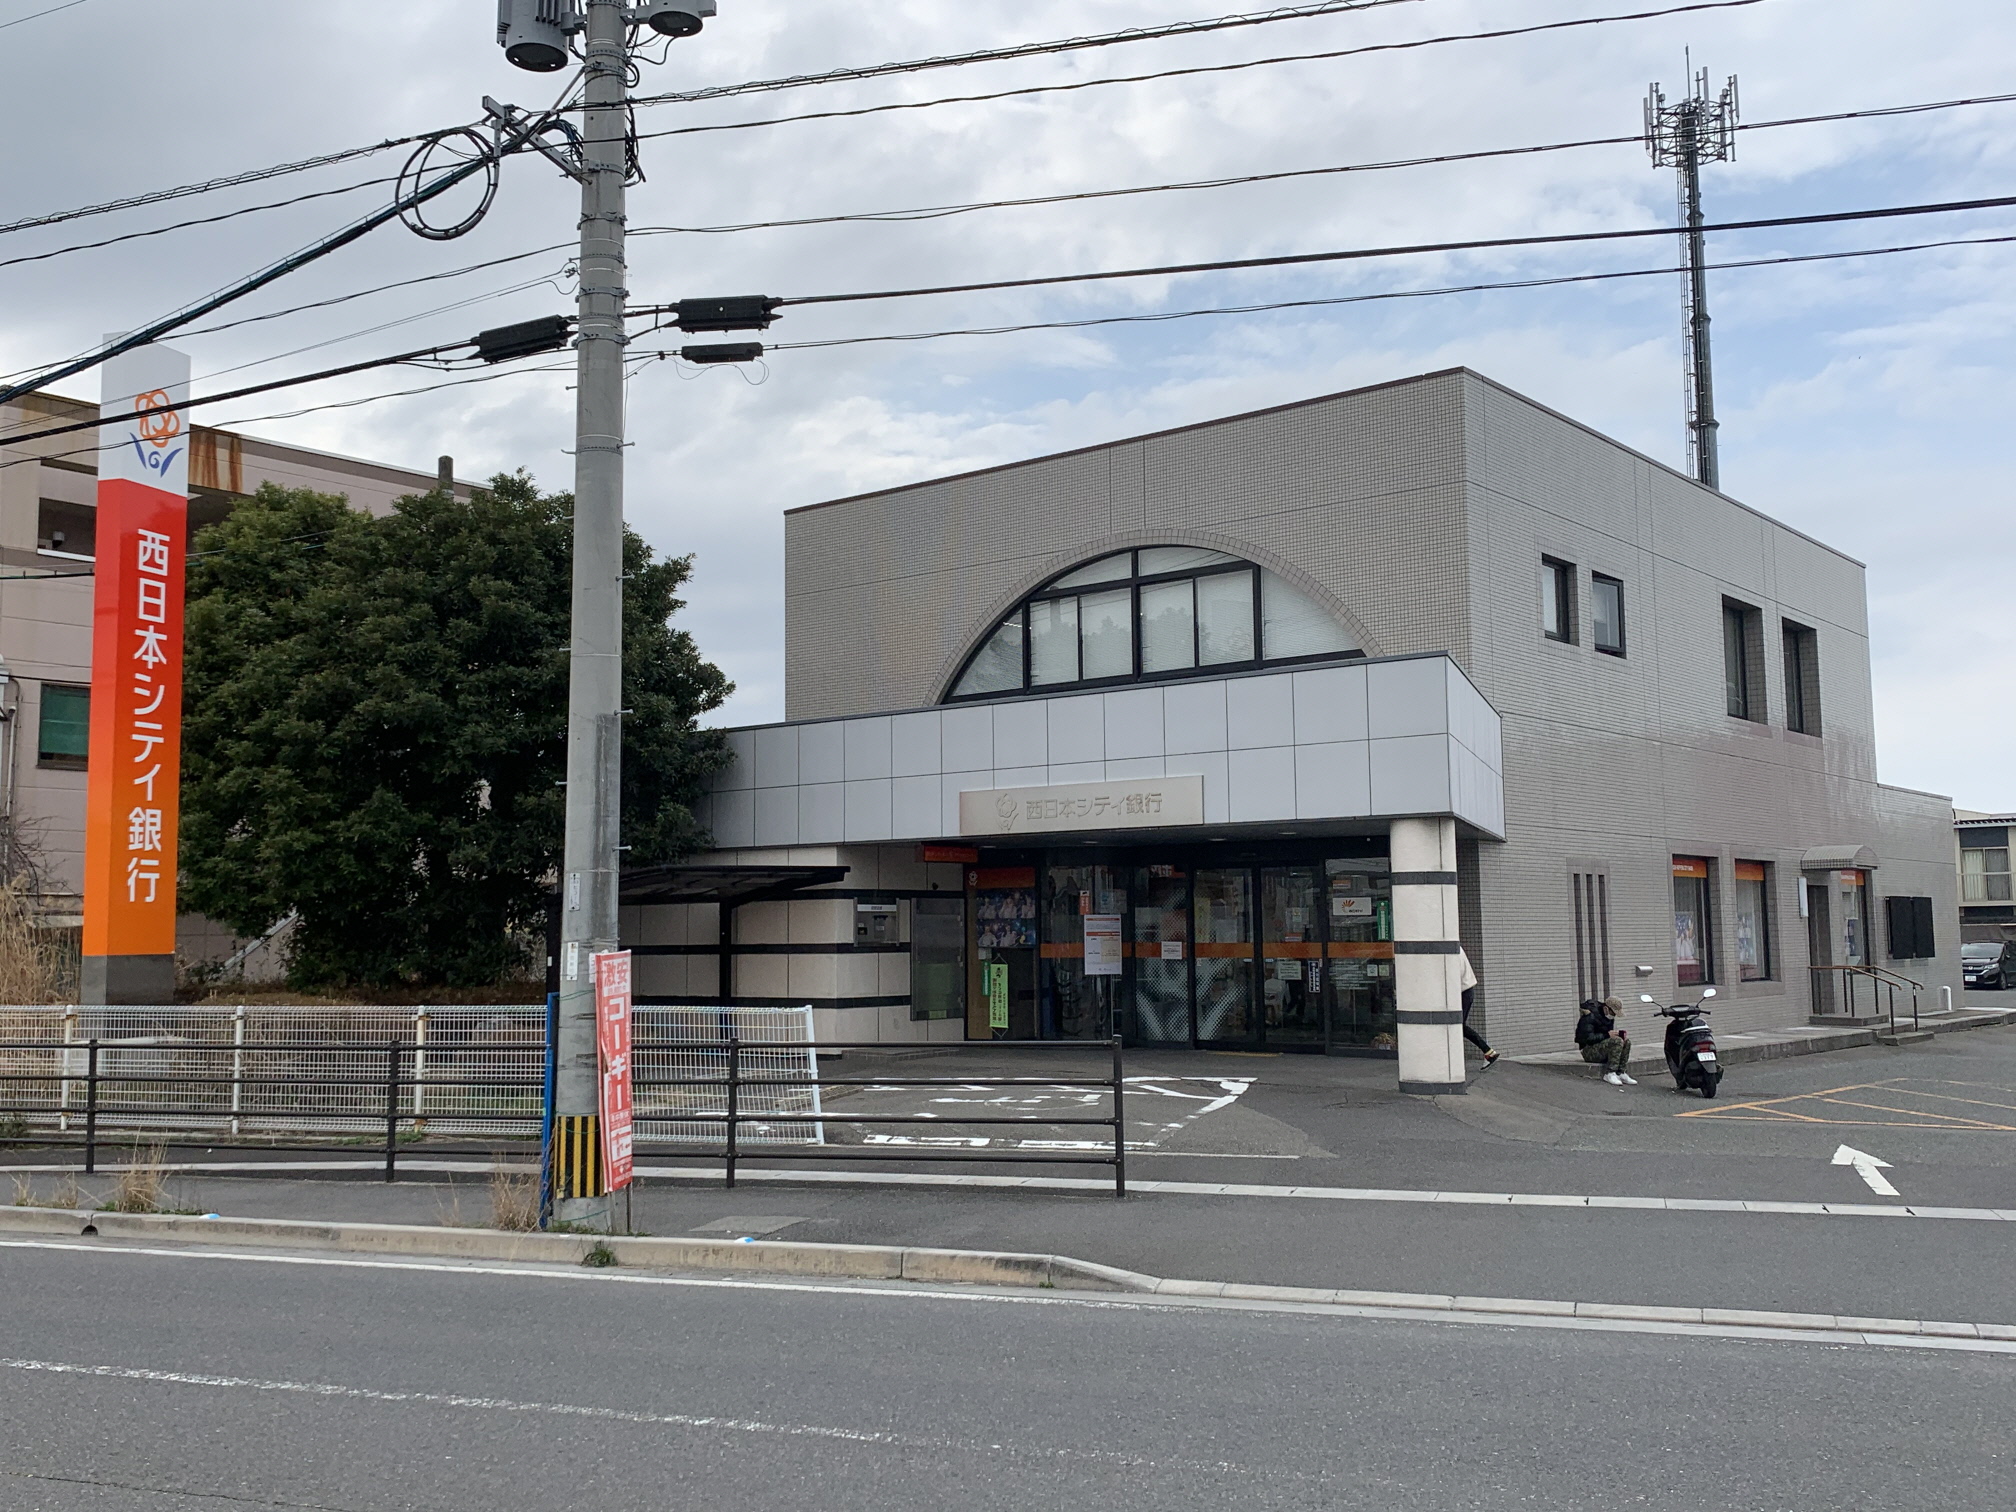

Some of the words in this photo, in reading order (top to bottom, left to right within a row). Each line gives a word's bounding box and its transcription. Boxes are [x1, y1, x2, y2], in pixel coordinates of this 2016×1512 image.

[127, 528, 171, 903] 西日本シティ銀行
[1026, 792, 1163, 820] 西日本シティ銀行
[603, 958, 628, 988] 激安
[609, 996, 628, 1110] コーギー
